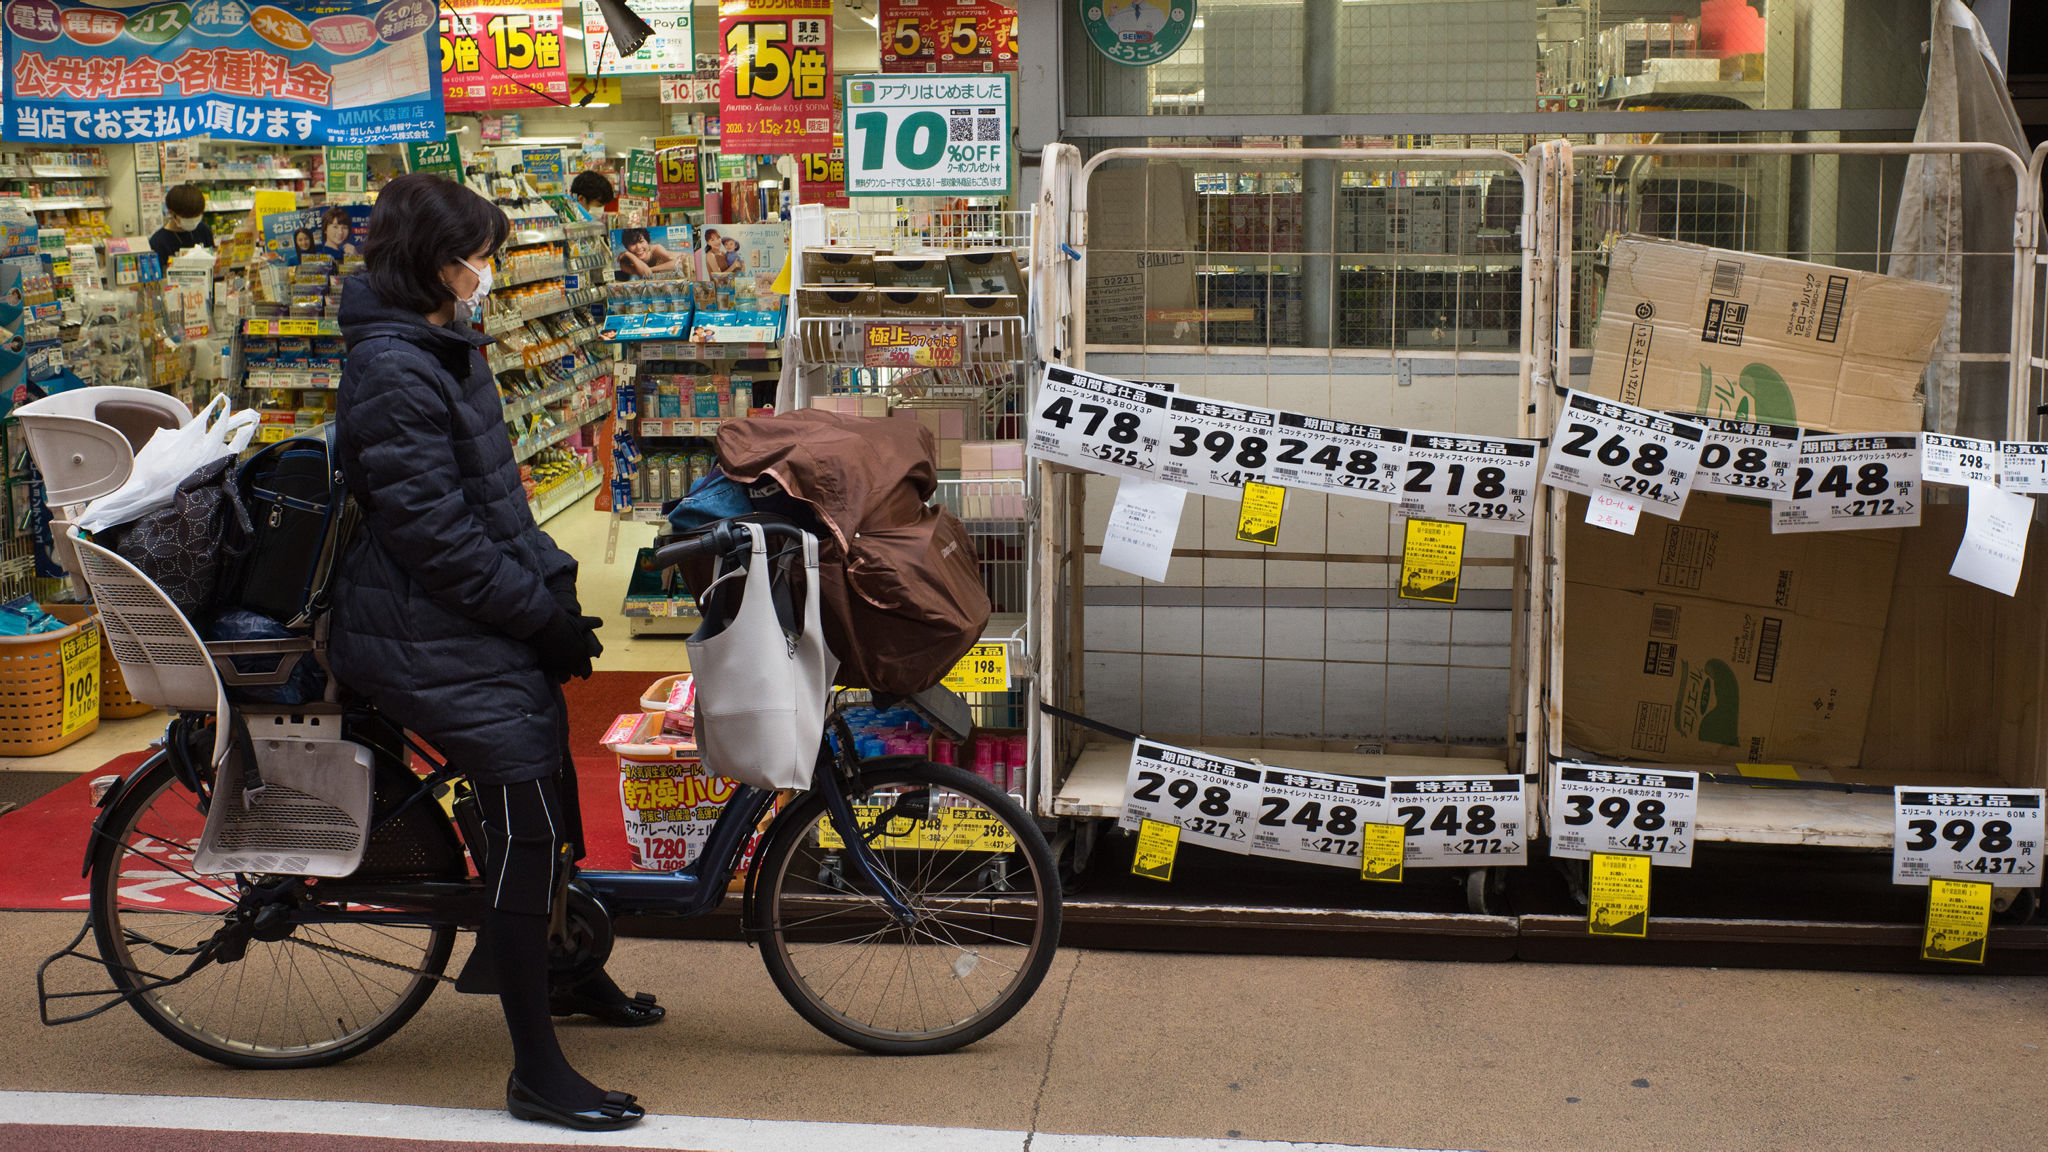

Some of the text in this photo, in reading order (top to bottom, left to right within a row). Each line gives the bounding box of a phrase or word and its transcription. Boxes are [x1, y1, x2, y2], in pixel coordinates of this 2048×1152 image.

[12, 5, 59, 33] 電気
[131, 9, 183, 33] ガス
[194, 1, 246, 26] 税金
[384, 2, 422, 23] その他
[66, 12, 120, 34] 電話
[256, 15, 307, 43] 水道
[382, 13, 429, 38] 各種料金
[798, 21, 819, 33] 現金
[315, 22, 372, 46] 通販
[487, 14, 561, 71] 15倍
[798, 34, 820, 43] ポイント
[725, 21, 827, 99] 15倍
[1108, 41, 1163, 59] ようこそ
[13, 48, 335, 106] 公共料金・各種料金
[879, 83, 1003, 101] アプリはじめました
[806, 103, 830, 111] SOFINA
[17, 100, 322, 140] 当店でお支払い頂けます
[417, 143, 450, 158] アプリ
[854, 111, 948, 171] 10
[330, 149, 364, 162] LINE@
[1104, 276, 1135, 286] 02221
[868, 325, 959, 348] 極上のフィット感
[889, 351, 910, 362] 500
[929, 347, 955, 361] 1000
[1070, 375, 1148, 404] 期間奉仕品
[1041, 395, 1142, 446] 478
[1195, 402, 1273, 426] 特売品
[1595, 402, 1676, 435] 特売品
[1303, 416, 1383, 440] 期間奉仕品
[1616, 423, 1646, 438] ホワイト
[1652, 433, 1667, 443] 4R
[1673, 438, 1696, 451] ダブル
[1144, 444, 1154, 453] 円
[1169, 425, 1269, 470] 398
[1391, 444, 1404, 453] 5P
[1427, 436, 1508, 456] 特売品
[1561, 423, 1668, 477] 268
[1801, 437, 1888, 454] 期間奉仕品
[1925, 435, 1993, 453] お買い得品
[1099, 443, 1138, 466] 525
[1276, 438, 1379, 475] 248
[1959, 453, 1983, 469] 298
[1385, 471, 1395, 480] 円
[1403, 461, 1506, 500] 218
[1670, 476, 1680, 486] 円
[1731, 473, 1769, 488] 338
[1775, 467, 1785, 477] 円
[1792, 462, 1890, 501] 248
[1344, 473, 1380, 492] 272
[1622, 476, 1663, 500] 294
[1898, 486, 1909, 497] 円
[1512, 495, 1522, 505] 円
[1852, 498, 1894, 516] 272
[1467, 502, 1508, 520] 239
[63, 629, 98, 661] 特売品
[974, 660, 995, 674] 198
[70, 672, 93, 708] 100
[1159, 750, 1236, 778] 期間奉仕品
[1282, 774, 1361, 794] 特売品
[1414, 781, 1494, 794] 特売品
[1586, 770, 1667, 788] 特売品
[1132, 771, 1232, 817] 298
[1927, 792, 2013, 808] 特売品
[1234, 816, 1244, 826] 円
[1257, 796, 1358, 835] 248
[1396, 804, 1497, 837] 248
[1563, 795, 1667, 832] 398
[1901, 808, 2037, 819] エリエール トイレットティシュー 60M S
[1190, 818, 1230, 839] 327
[1505, 828, 1514, 837] 円
[1673, 827, 1683, 836] 円
[1905, 818, 2013, 852] 398
[643, 837, 687, 860] 1280
[1321, 838, 1359, 857] 272
[1462, 838, 1503, 854] 272
[1627, 834, 1668, 853] 437
[2022, 847, 2031, 856] 円
[1973, 856, 2017, 874] 437
